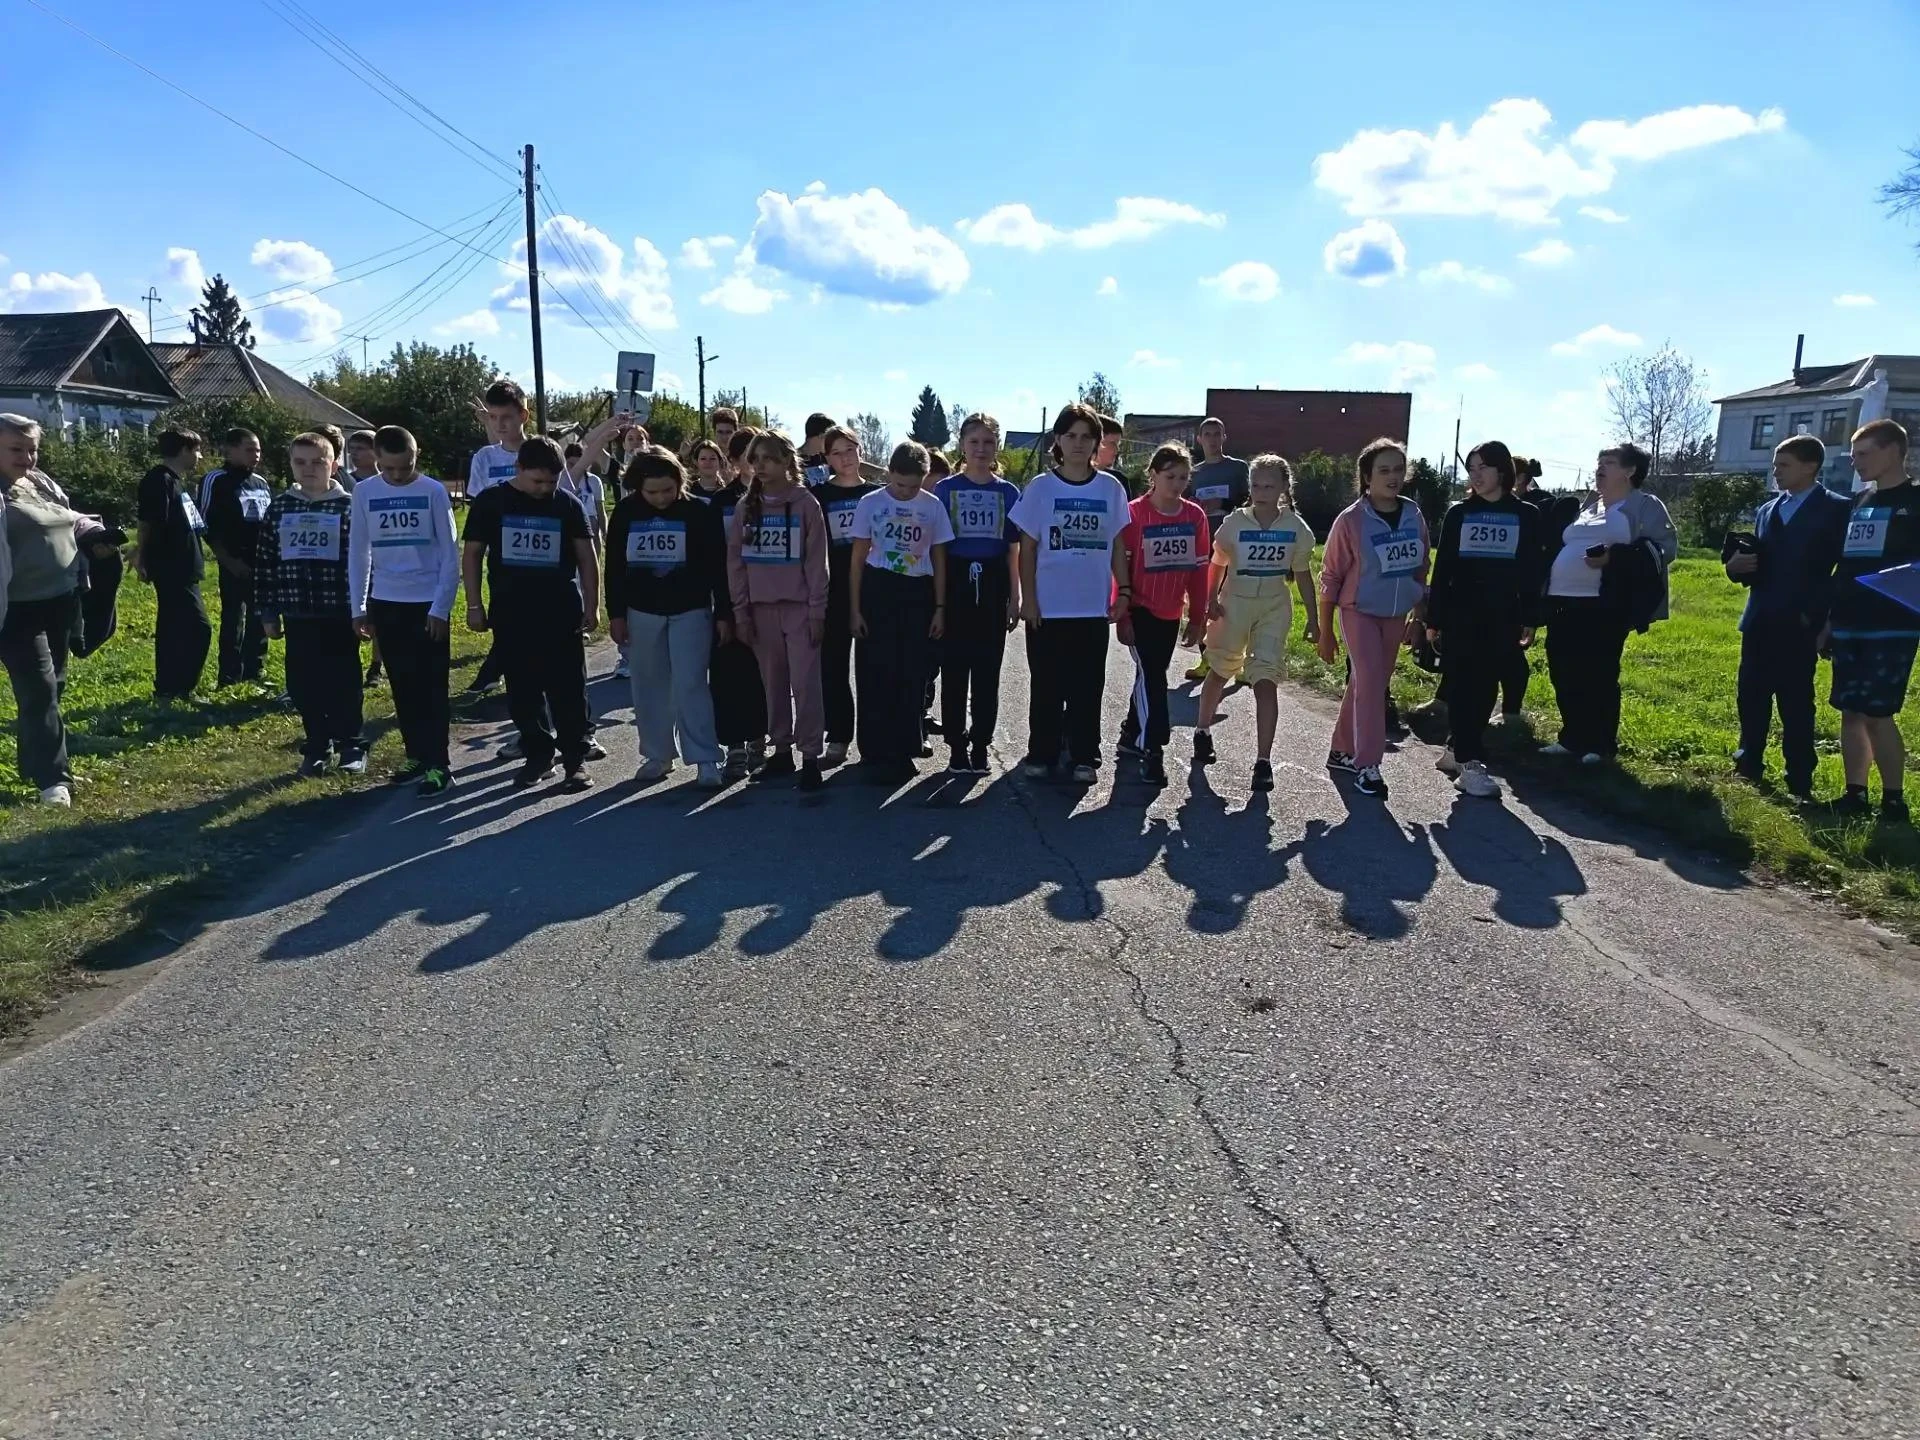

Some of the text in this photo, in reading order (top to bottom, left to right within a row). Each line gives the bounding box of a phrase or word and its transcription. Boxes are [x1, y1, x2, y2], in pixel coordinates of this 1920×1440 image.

[379, 512, 419, 529] 2105
[961, 510, 994, 526] 1911
[1063, 513, 1099, 531] 2459
[290, 531, 329, 547] 2428
[885, 522, 922, 542] 2450
[1470, 526, 1507, 542] 2519
[512, 532, 551, 551] 2165
[638, 534, 677, 551] 2165
[1153, 539, 1187, 556] 2459
[1247, 545, 1286, 561] 2225
[1386, 542, 1418, 561] 2045
